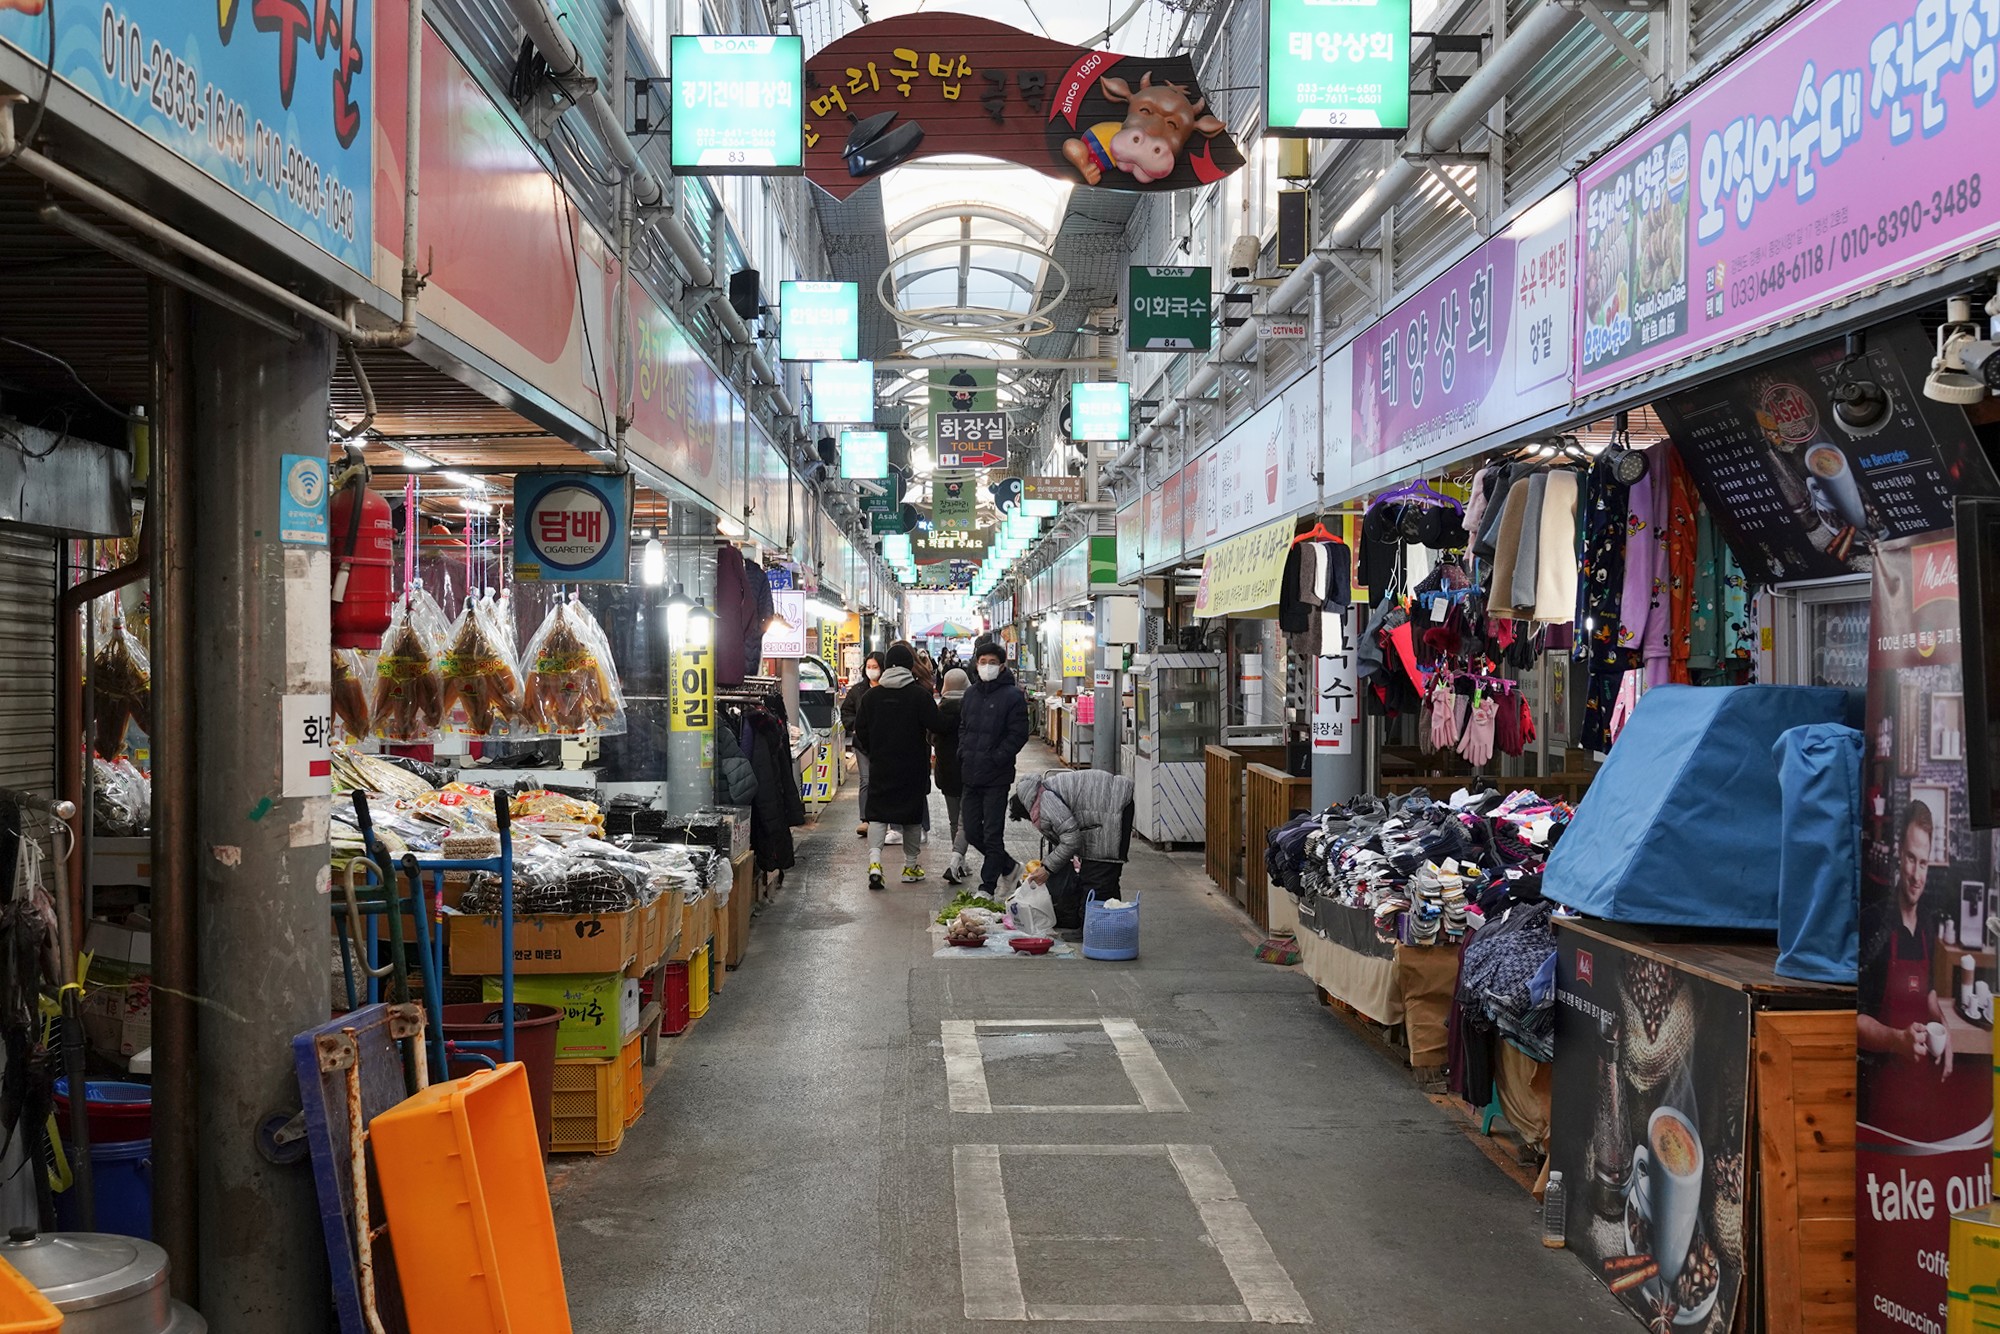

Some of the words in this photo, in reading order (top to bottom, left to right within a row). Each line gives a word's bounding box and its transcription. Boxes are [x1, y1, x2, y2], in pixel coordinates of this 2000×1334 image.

[1289, 32, 1393, 62] 태양상회
[1062, 82, 1080, 114] since
[1076, 54, 1102, 79] 1950
[1297, 83, 1382, 93] 033-646-6501
[1297, 94, 1382, 104] 010-7611-6501
[1329, 112, 1347, 124] 82
[728, 151, 745, 162] 83
[1698, 62, 1862, 243] 오징어순대
[254, 119, 354, 243] 010-9996-1648
[1635, 144, 1665, 211] 명품
[1841, 173, 1981, 263] 010-8390-3488
[1134, 296, 1206, 318] 이화국수
[1164, 339, 1176, 347] 84
[1381, 263, 1493, 409] 태양상회
[1530, 315, 1552, 365] 양말
[1769, 391, 1811, 423] Asak
[940, 418, 1004, 440] 화장실
[951, 441, 993, 451] TOILET
[1859, 455, 1871, 470] Ice
[1872, 449, 1909, 468] Beverages
[538, 511, 601, 543] 담배
[544, 545, 594, 554] CIGARETTES
[957, 540, 983, 548] 주세요
[769, 579, 788, 588] 16-2
[1878, 636, 1901, 650] 100년
[1919, 632, 1936, 647] 독일
[1937, 628, 1953, 643] 커피
[1313, 722, 1343, 736] 화장실
[535, 949, 562, 960] 마른김
[1867, 1168, 1935, 1221] take
[1946, 1163, 1992, 1216] out
[1874, 1294, 1941, 1334] cappuccino
